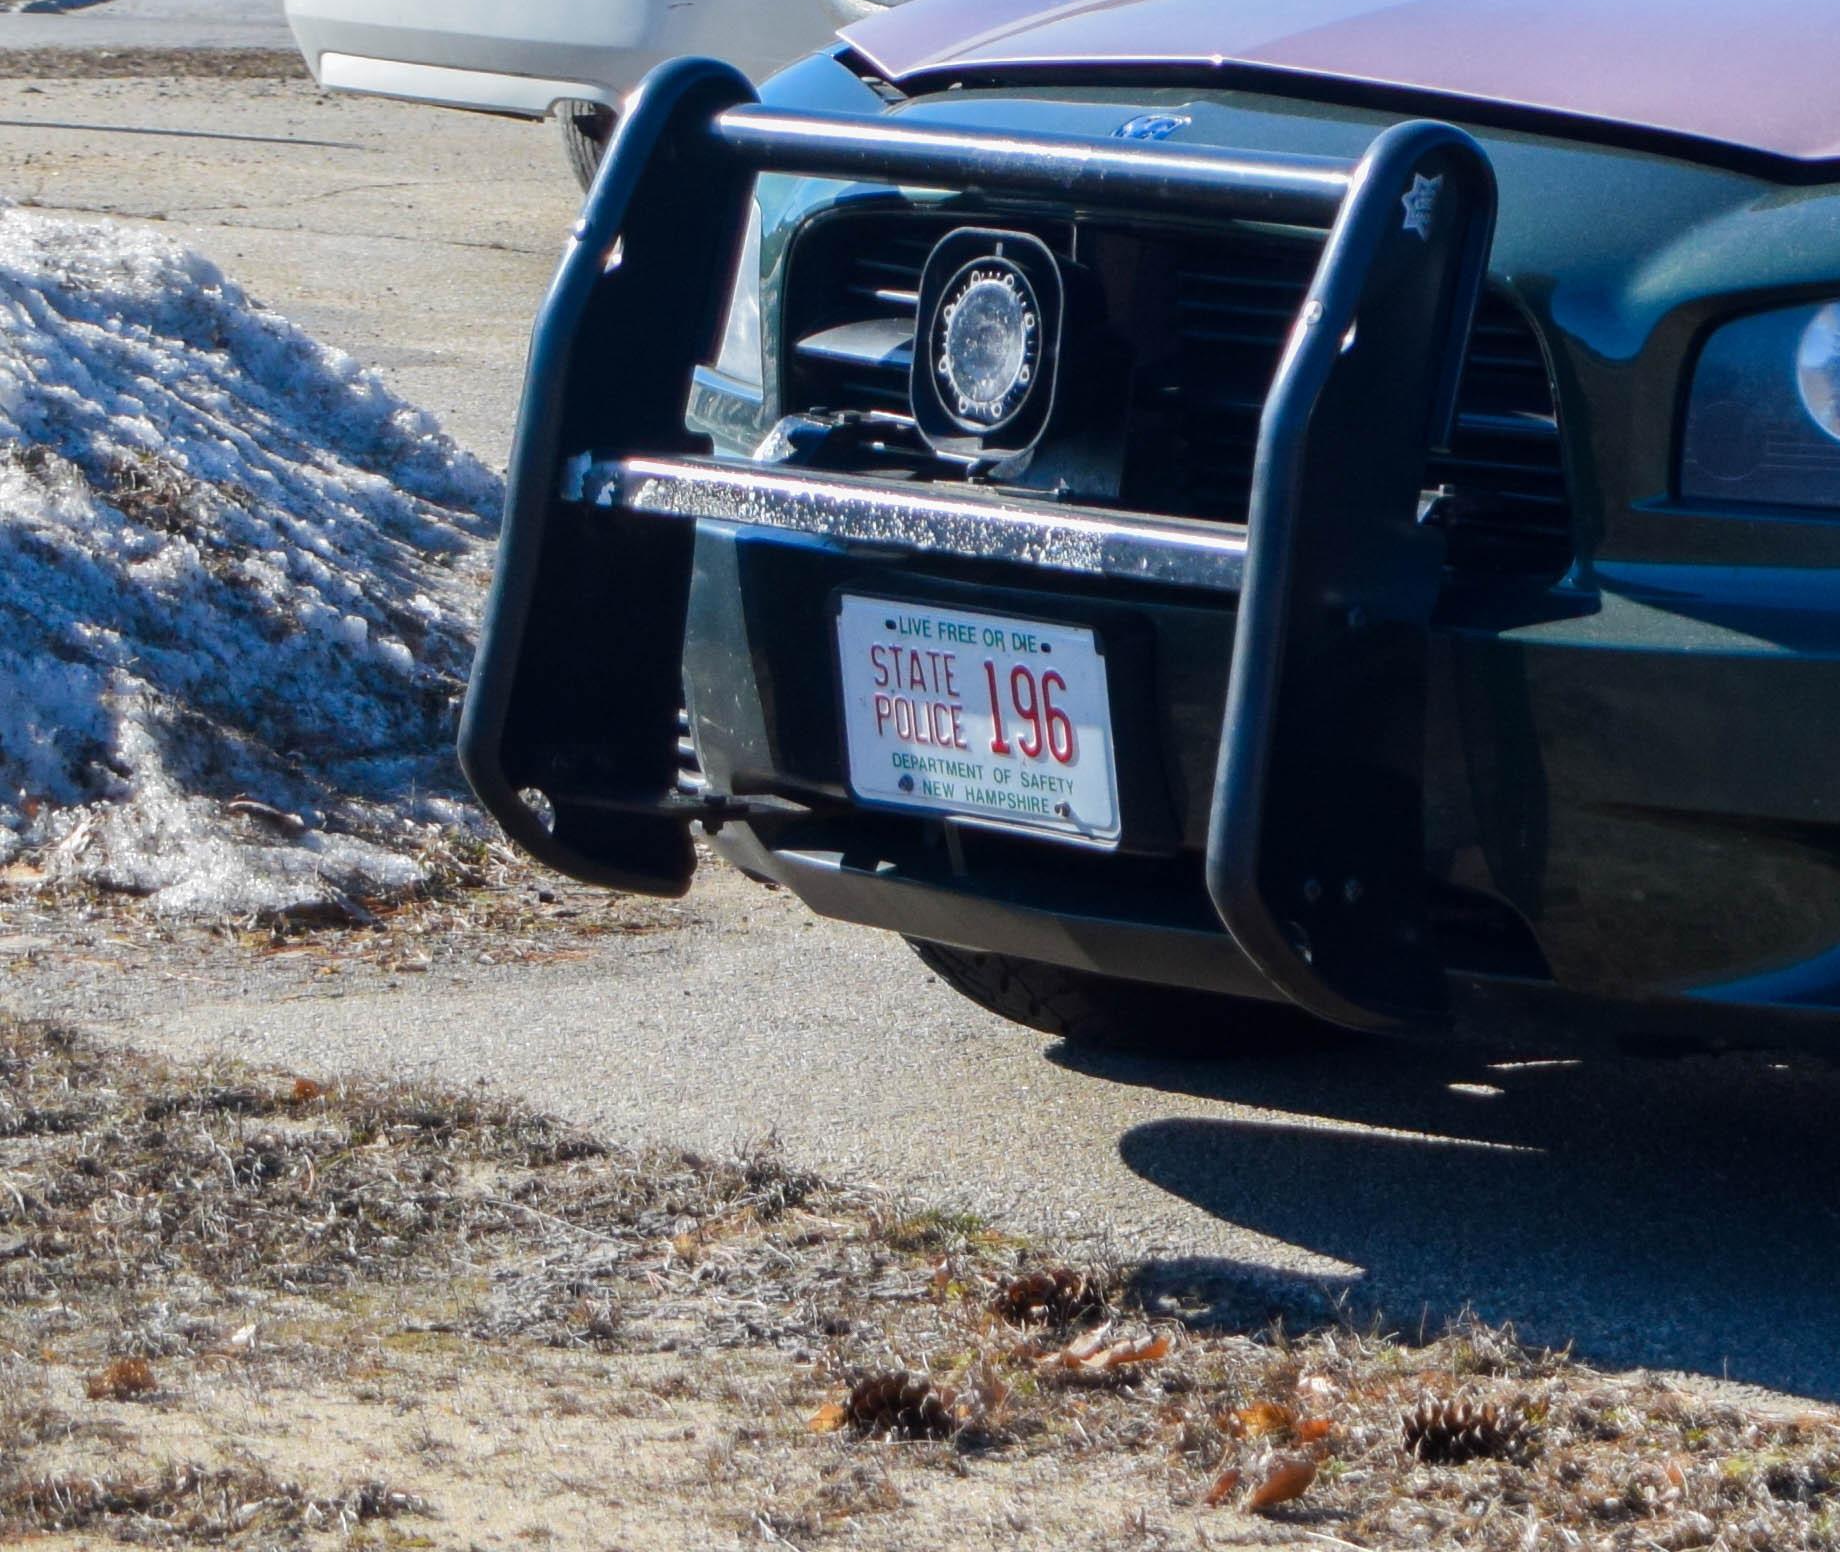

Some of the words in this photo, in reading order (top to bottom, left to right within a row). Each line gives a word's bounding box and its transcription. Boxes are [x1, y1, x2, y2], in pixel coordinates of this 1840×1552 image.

[899, 615, 931, 639] LIVE
[938, 621, 977, 645] FREE
[983, 627, 1004, 649] OR
[1012, 631, 1037, 653] DIE
[870, 643, 960, 697] STATE
[873, 694, 968, 749] POLICE
[983, 659, 1074, 765] 196
[892, 752, 984, 781] DEPARTMENT
[993, 767, 1011, 785] OF
[1020, 771, 1074, 795] SAFETY
[922, 779, 955, 798] NEW
[965, 784, 1050, 814] HAMPSHIRE
